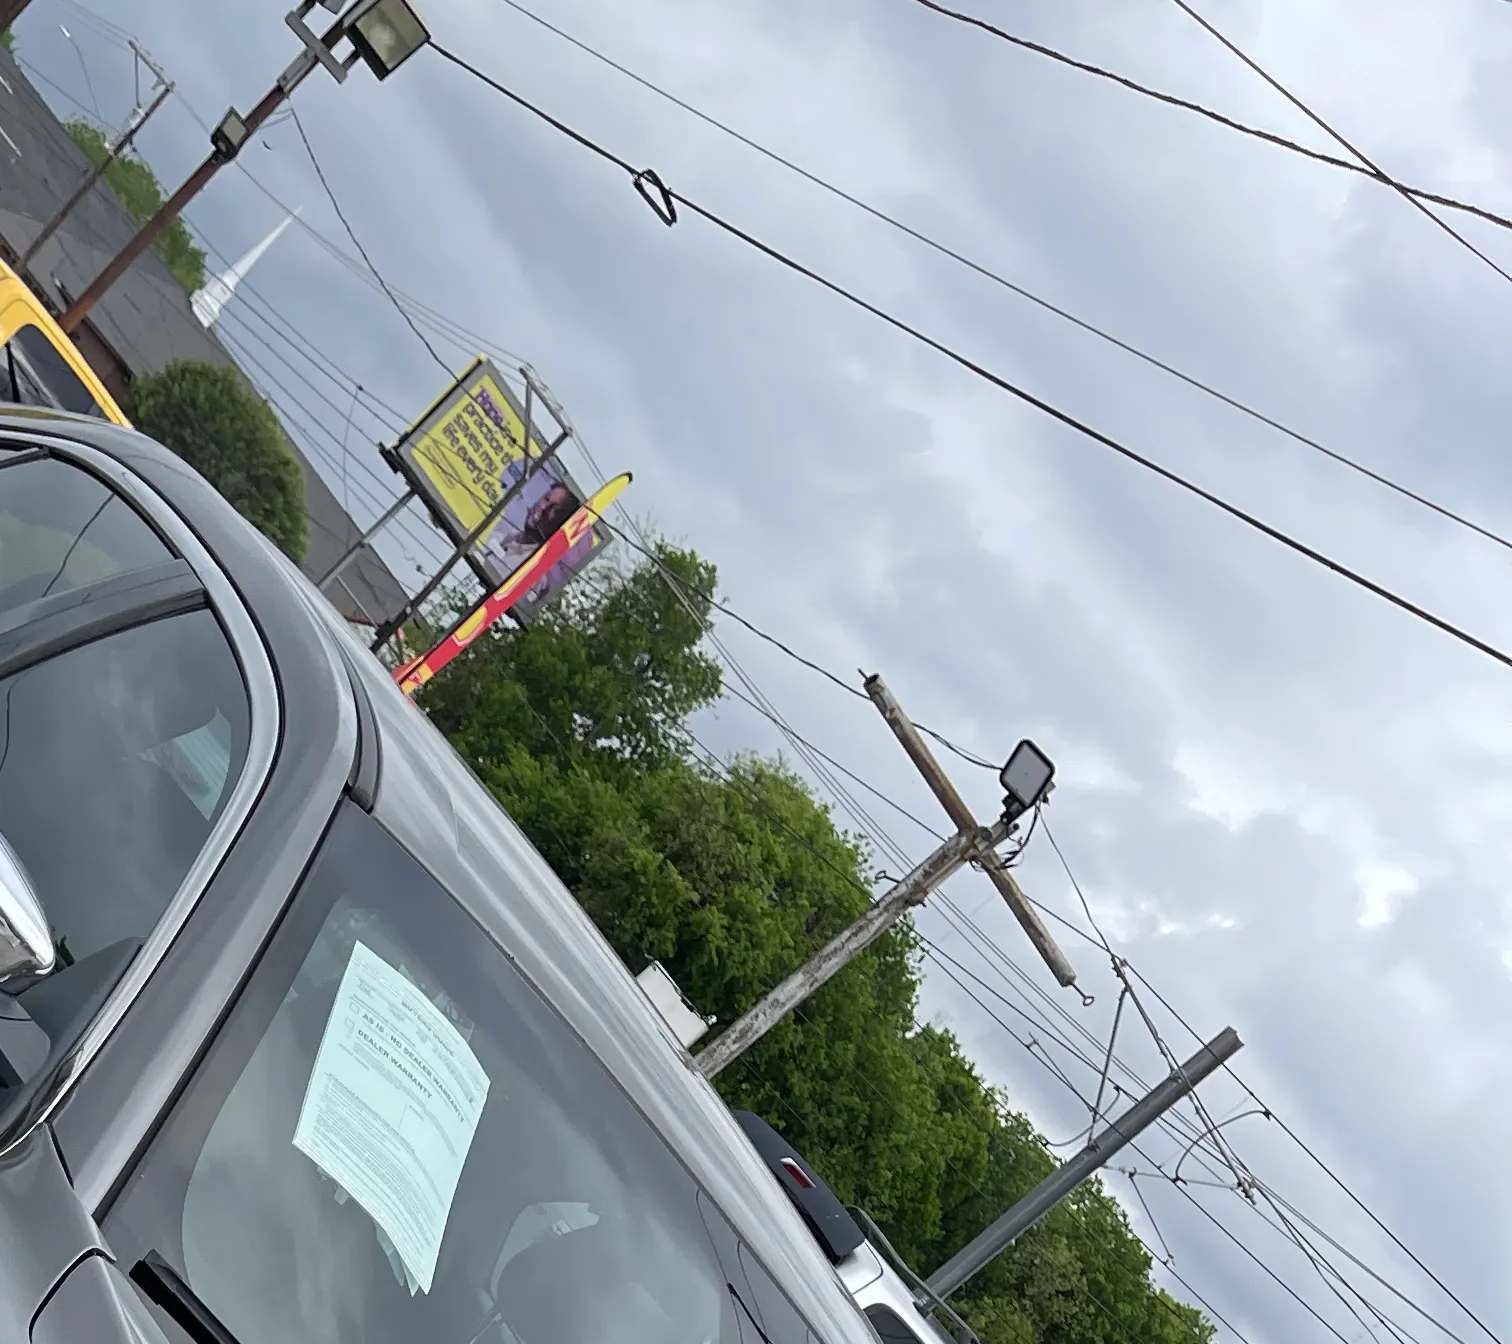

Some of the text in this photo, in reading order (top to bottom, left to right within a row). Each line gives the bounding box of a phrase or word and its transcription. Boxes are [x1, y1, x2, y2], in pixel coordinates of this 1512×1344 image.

[358, 1029, 389, 1058] DEALER
[390, 1055, 432, 1098] WARRANTY
[362, 1013, 374, 1025] AS
[390, 1035, 403, 1049] NO
[403, 1046, 433, 1078] DEALER
[433, 1076, 465, 1122] WARRANTY
